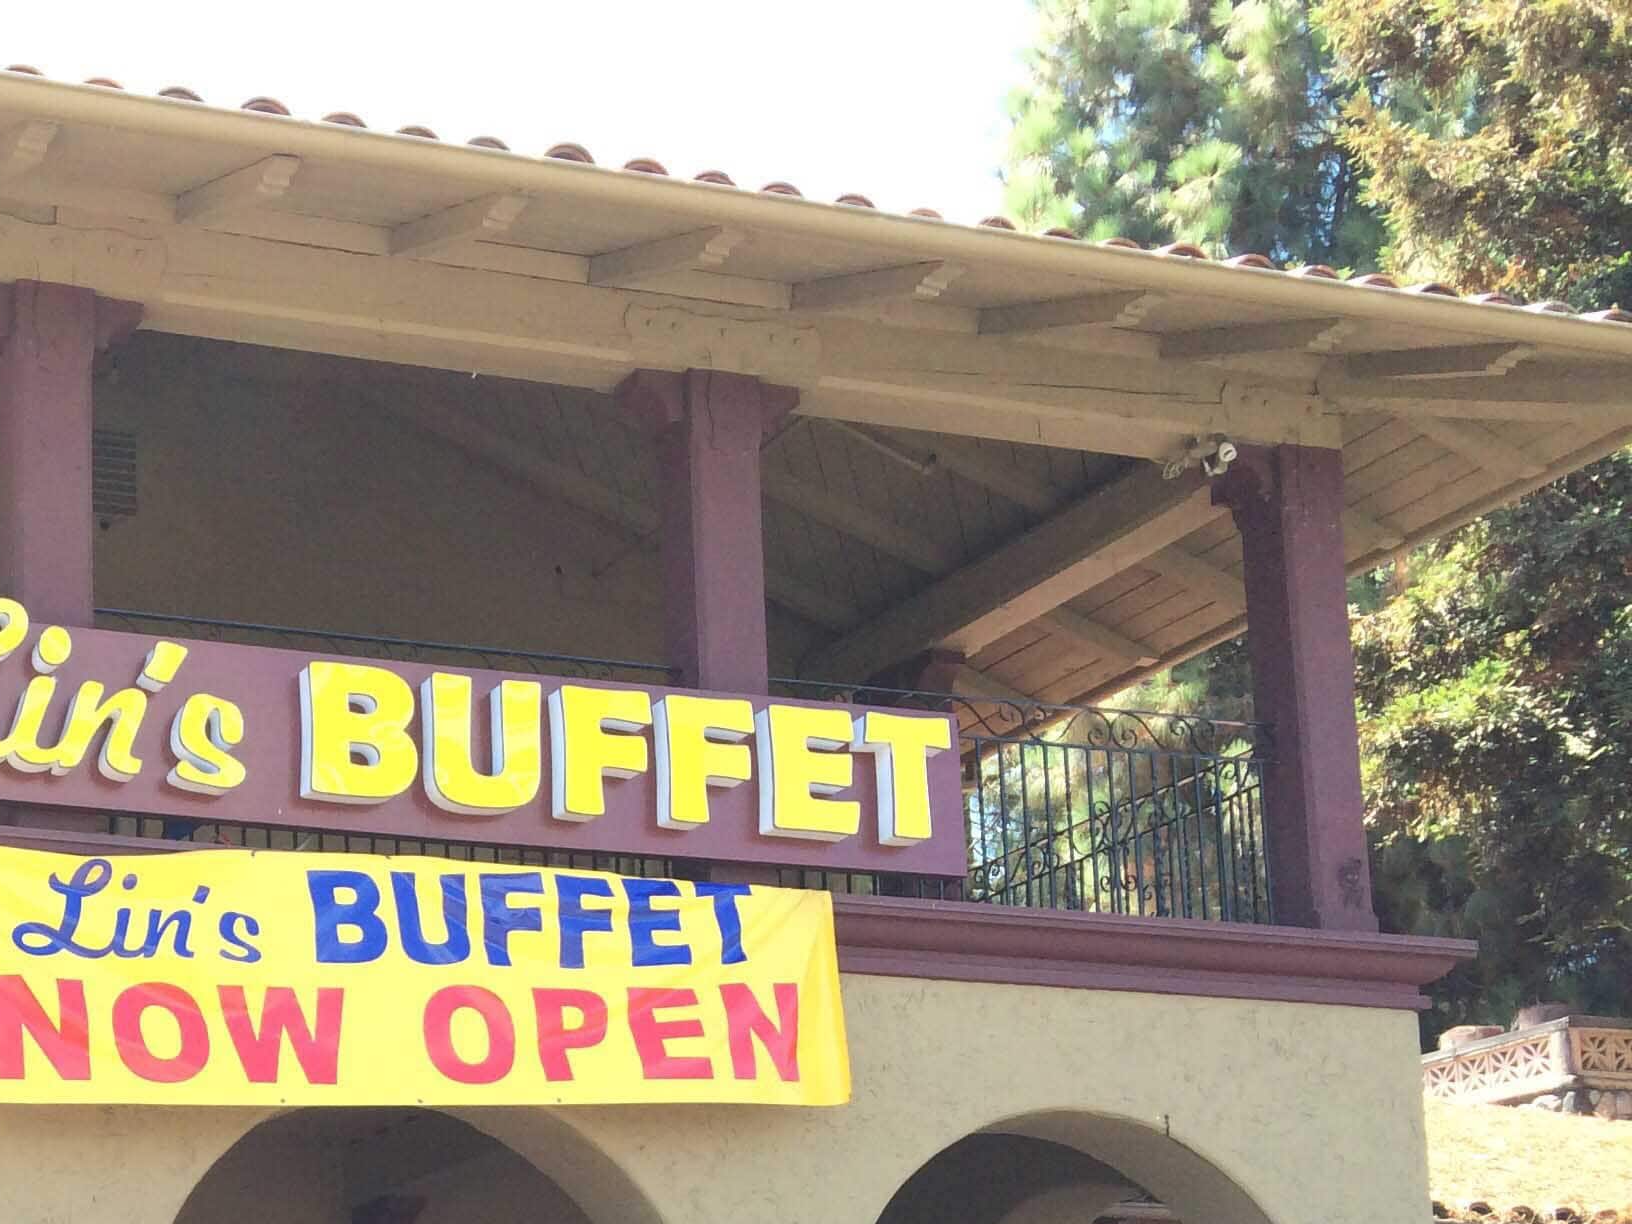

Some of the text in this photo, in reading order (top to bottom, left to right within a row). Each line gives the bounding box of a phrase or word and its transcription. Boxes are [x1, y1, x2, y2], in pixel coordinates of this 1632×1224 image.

[299, 661, 952, 847] BUFFET
[11, 858, 752, 968] Lin's BUFFET
[423, 984, 800, 1085] OPEN
